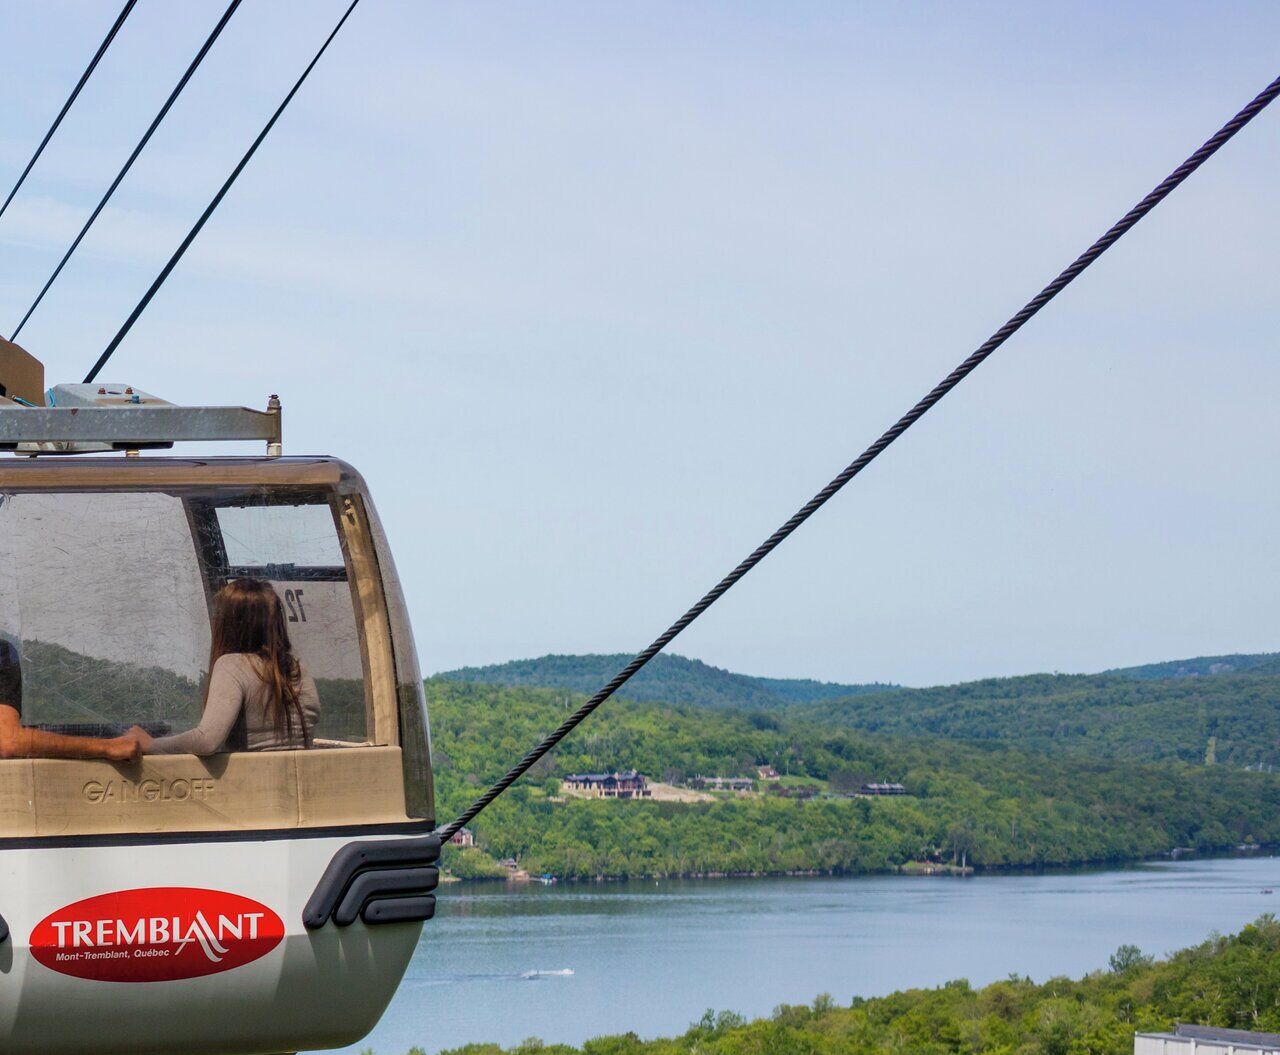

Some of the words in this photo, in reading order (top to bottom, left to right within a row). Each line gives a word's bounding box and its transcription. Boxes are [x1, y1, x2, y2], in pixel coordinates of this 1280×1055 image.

[82, 778, 215, 804] GANGLOFF
[51, 910, 265, 962] TREMBLANT
[55, 950, 131, 962] Mont-Tremblant,
[134, 948, 170, 959] Québec
